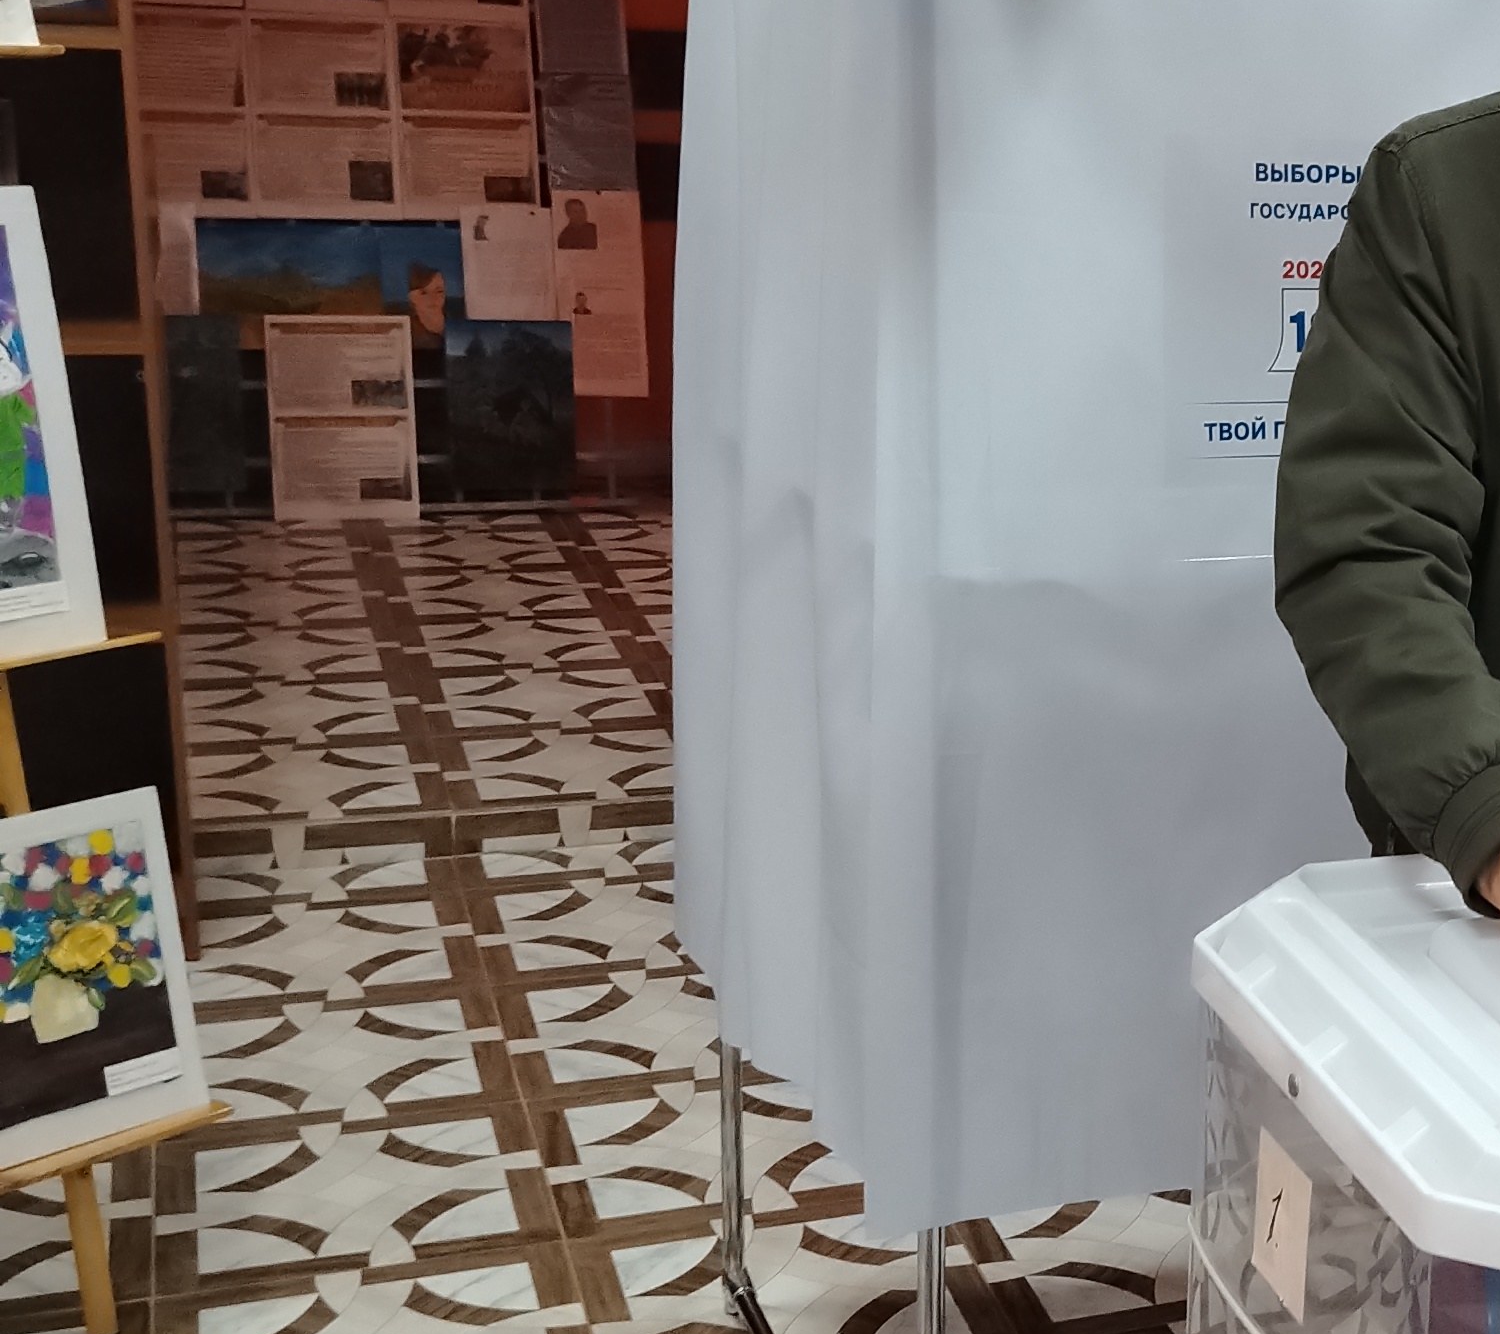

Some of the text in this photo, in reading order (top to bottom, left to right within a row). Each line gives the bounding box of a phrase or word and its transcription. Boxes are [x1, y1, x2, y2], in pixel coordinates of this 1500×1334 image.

[1255, 162, 1362, 184] ВЫБОРЫ
[1250, 202, 1349, 223] ГОСУДАРС
[1282, 260, 1323, 279] 202
[1289, 310, 1306, 353] 1
[1203, 415, 1266, 442] ТВОЙ
